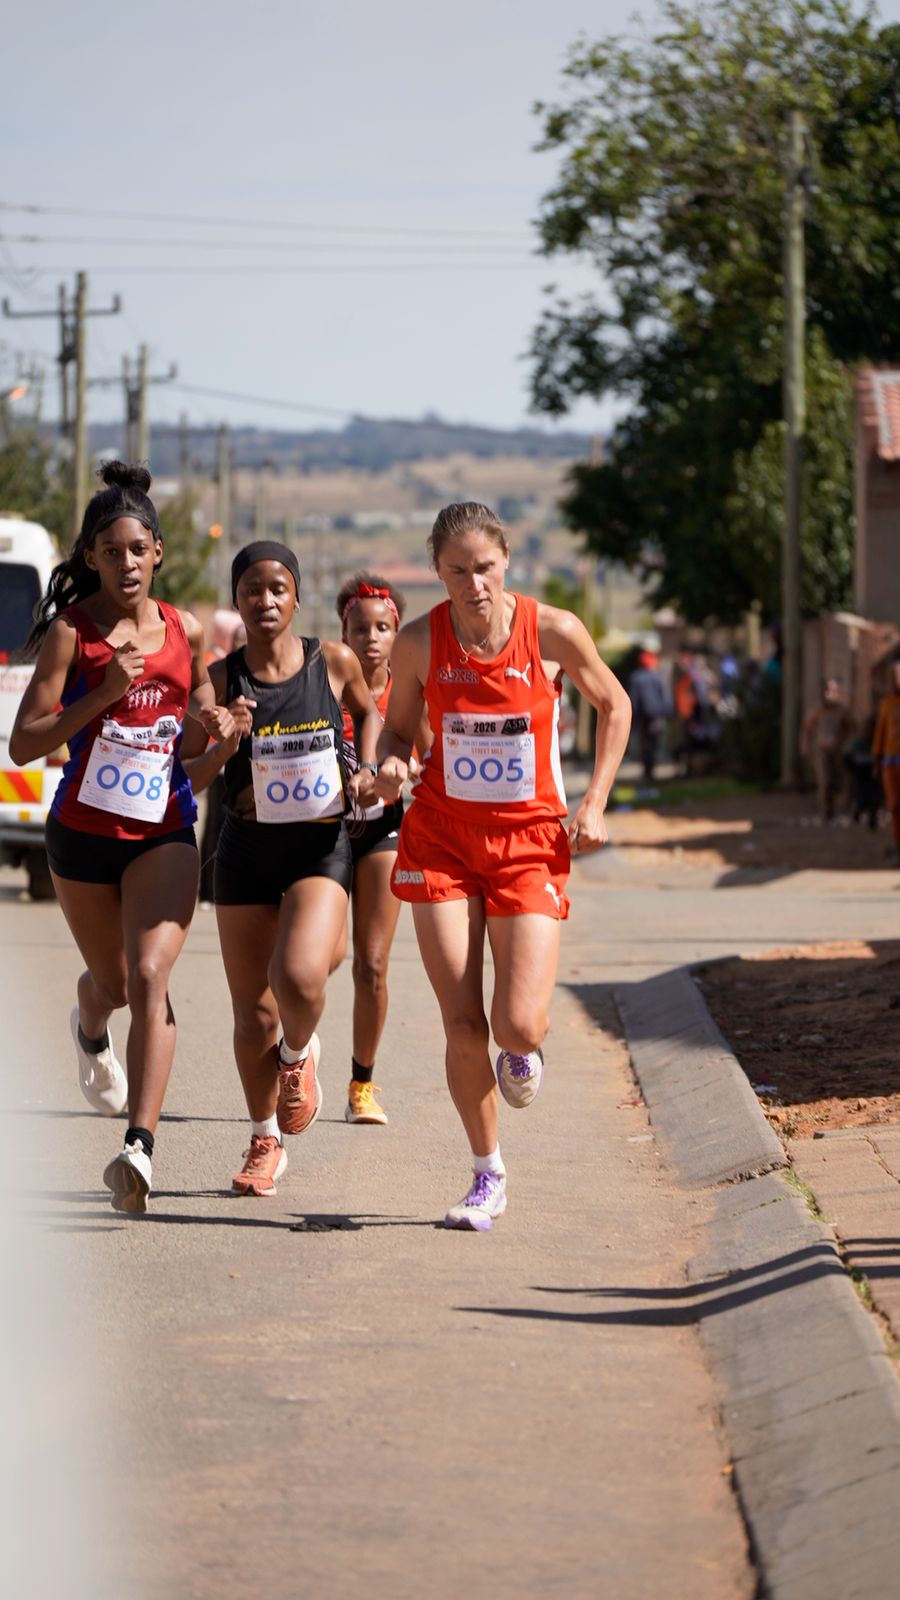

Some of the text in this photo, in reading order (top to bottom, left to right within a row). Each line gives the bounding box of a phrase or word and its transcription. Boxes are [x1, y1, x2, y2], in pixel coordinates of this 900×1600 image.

[473, 721, 497, 734] 2026
[283, 740, 305, 753] 2026
[453, 756, 525, 782] 005
[96, 764, 164, 801] 008
[266, 773, 331, 804] 066
